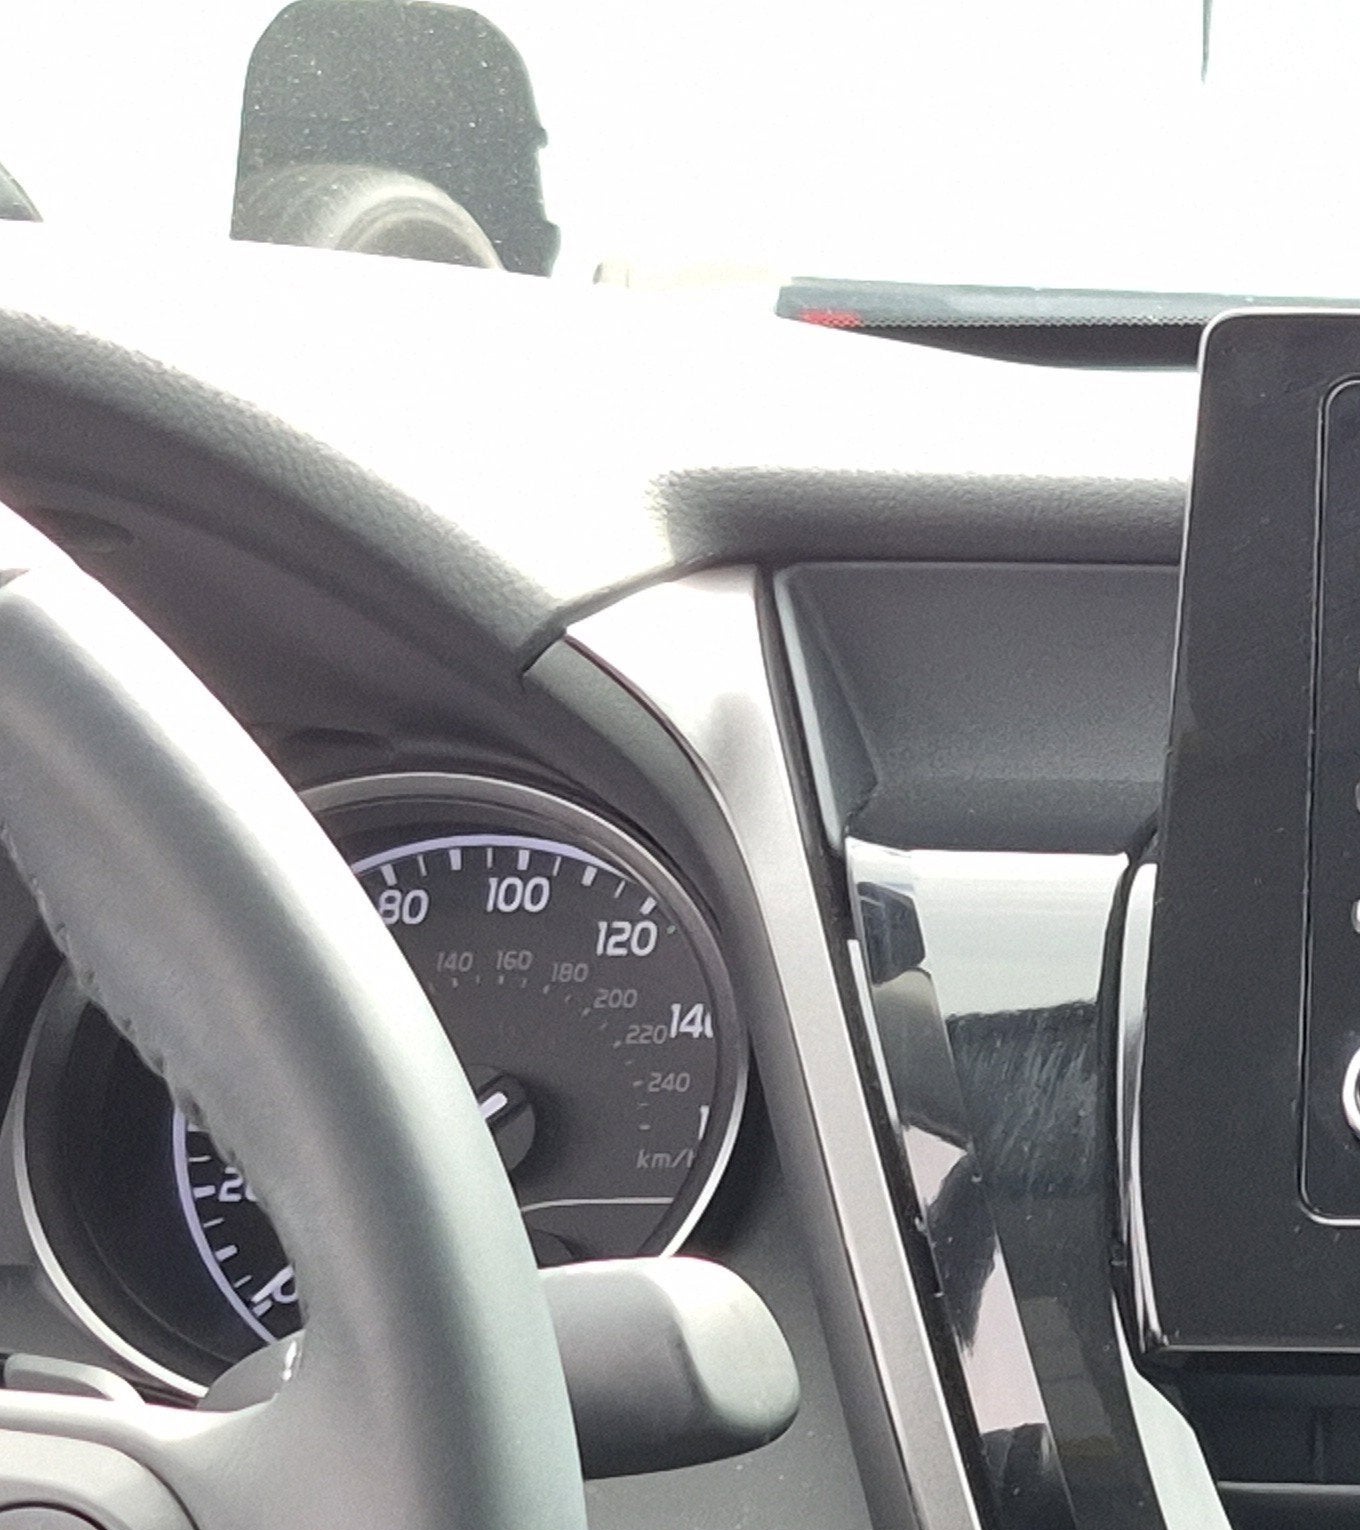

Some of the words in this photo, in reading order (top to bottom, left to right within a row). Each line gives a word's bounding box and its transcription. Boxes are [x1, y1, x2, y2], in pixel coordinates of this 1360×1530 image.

[486, 876, 551, 913] 100
[379, 889, 430, 925] 80
[596, 920, 658, 957] 120
[437, 952, 473, 972] 140
[496, 950, 533, 971] 160
[550, 963, 589, 983] 180
[593, 988, 638, 1008] 200
[625, 1025, 668, 1045] 220
[649, 1073, 691, 1093] 240
[218, 1166, 256, 1202] 2
